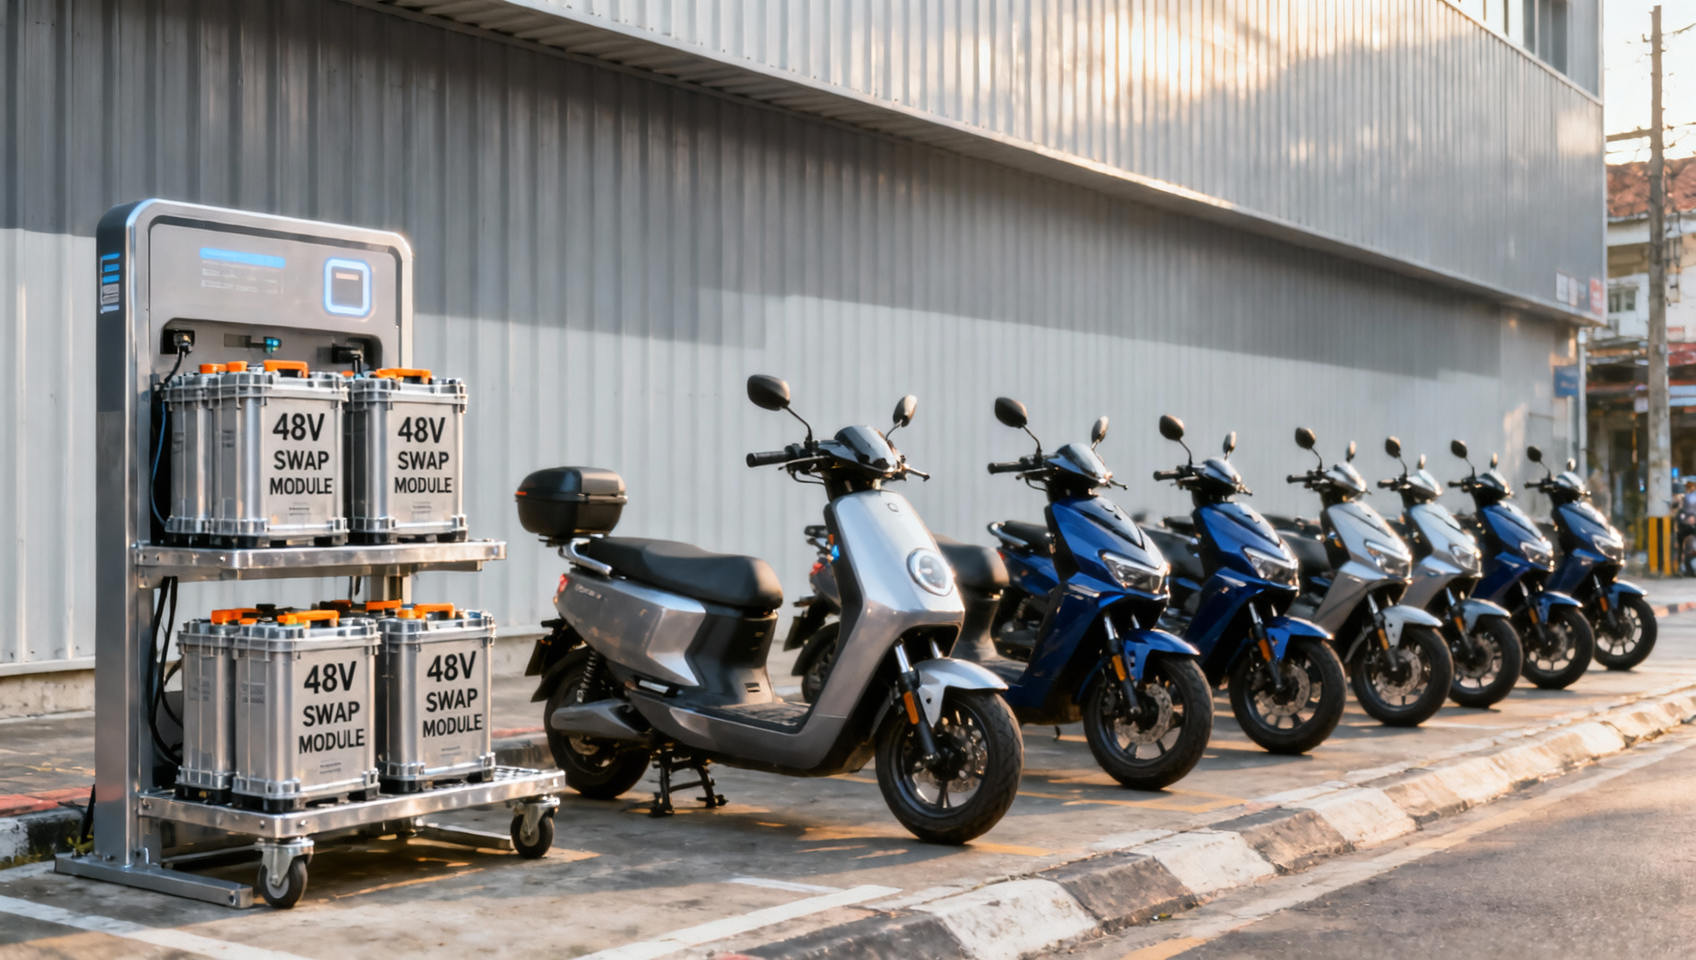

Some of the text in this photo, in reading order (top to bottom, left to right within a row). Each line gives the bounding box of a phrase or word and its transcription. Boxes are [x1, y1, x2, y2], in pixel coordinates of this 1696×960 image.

[272, 413, 325, 441] 48V
[398, 416, 446, 443] 48V
[273, 450, 330, 471] SWAP
[397, 451, 449, 470] SWAP
[269, 477, 333, 495] MODULE
[394, 477, 452, 494] MODULE
[304, 661, 357, 694] 48V
[427, 651, 477, 682] 48V
[426, 688, 478, 713] SWAP
[302, 701, 360, 727] SWAP
[423, 714, 482, 738] MODULE
[299, 728, 365, 754] MODULE
